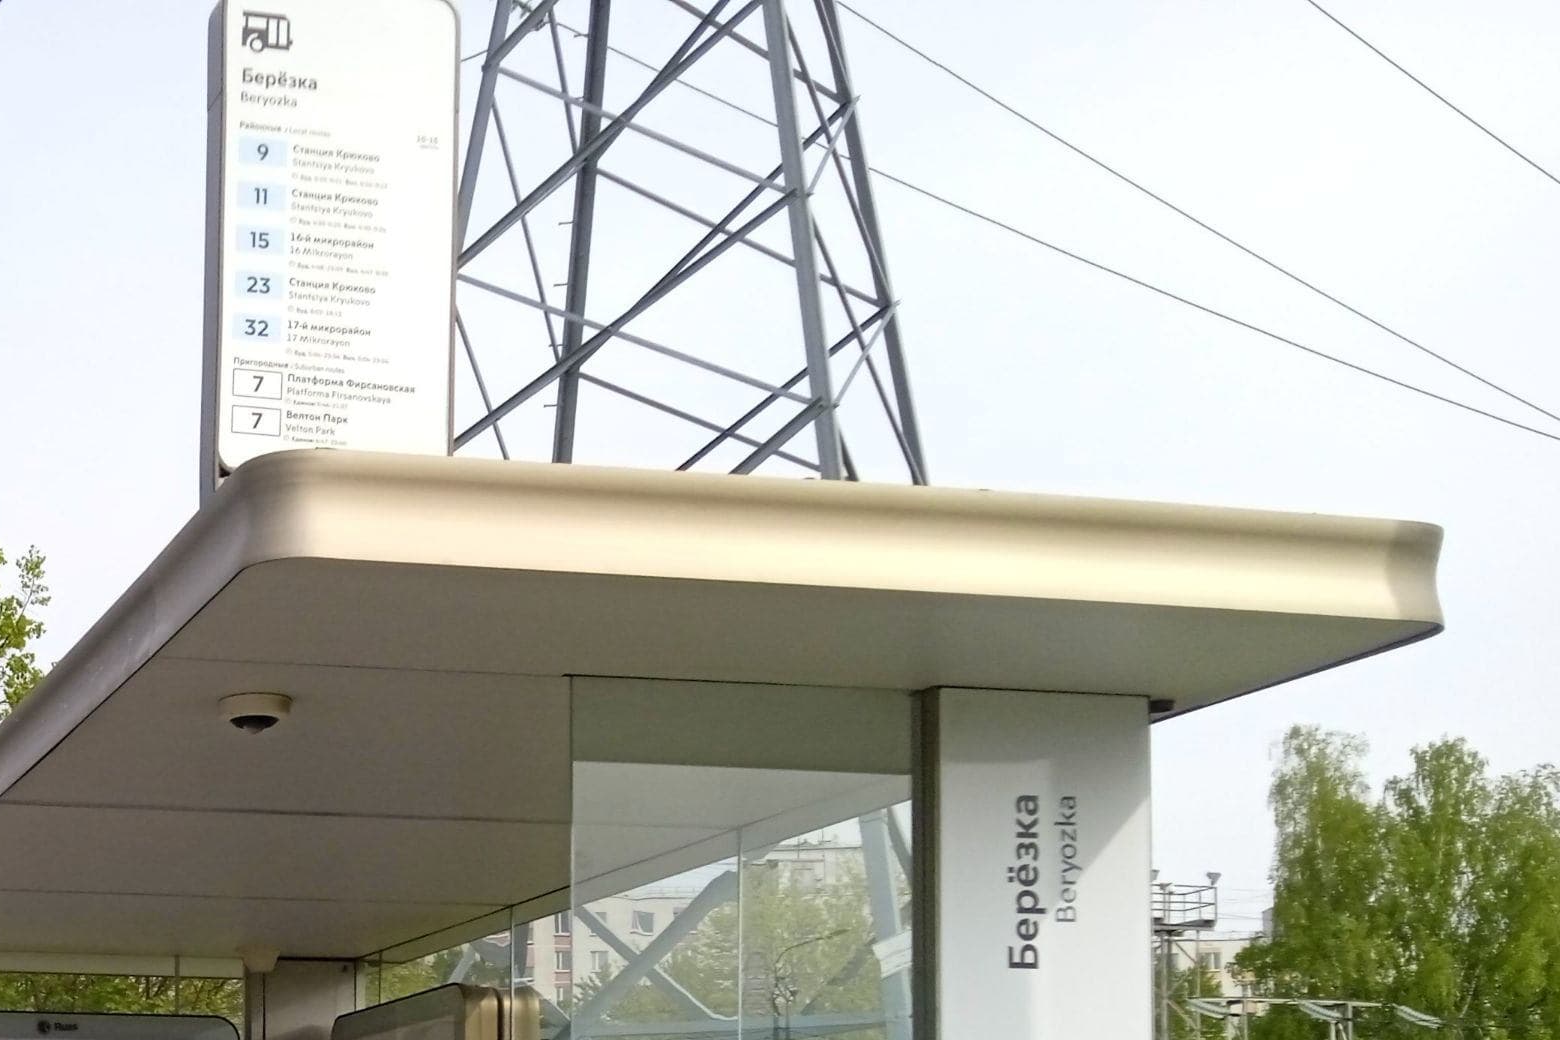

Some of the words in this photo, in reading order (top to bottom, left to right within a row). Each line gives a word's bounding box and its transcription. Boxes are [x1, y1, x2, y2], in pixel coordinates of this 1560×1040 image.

[242, 68, 318, 91] Берёзка
[240, 91, 298, 108] Beryozka
[257, 143, 269, 161] 9
[293, 144, 333, 158] Станция
[335, 149, 380, 163] Крюково
[254, 187, 268, 206] 11
[291, 188, 332, 202] Станция
[334, 193, 379, 207] Крюково
[249, 231, 270, 250] 15
[313, 235, 375, 250] микрорайон
[302, 246, 354, 261] Mikrorayon
[246, 276, 271, 294] 23
[289, 278, 330, 292] Станция
[332, 282, 376, 295] Крюково
[288, 291, 329, 304] Stantsiya
[330, 295, 371, 307] Kryukovo
[244, 319, 269, 337] 32
[287, 320, 308, 332] 17-й
[310, 324, 371, 338] микрорайон
[286, 333, 297, 343] 17
[299, 334, 351, 349] Mikrorayon
[252, 375, 264, 393] 7
[287, 373, 344, 388] Платформа
[346, 378, 416, 395] Фирсановская
[287, 386, 330, 399] Platforma
[331, 390, 391, 405] Firsanovskaya
[251, 412, 263, 430] 7
[286, 410, 321, 423] Велтон
[323, 413, 348, 426] Парк
[315, 425, 336, 437] Park
[1054, 795, 1083, 923] Beryozka
[1007, 794, 1047, 969] Берёзка
